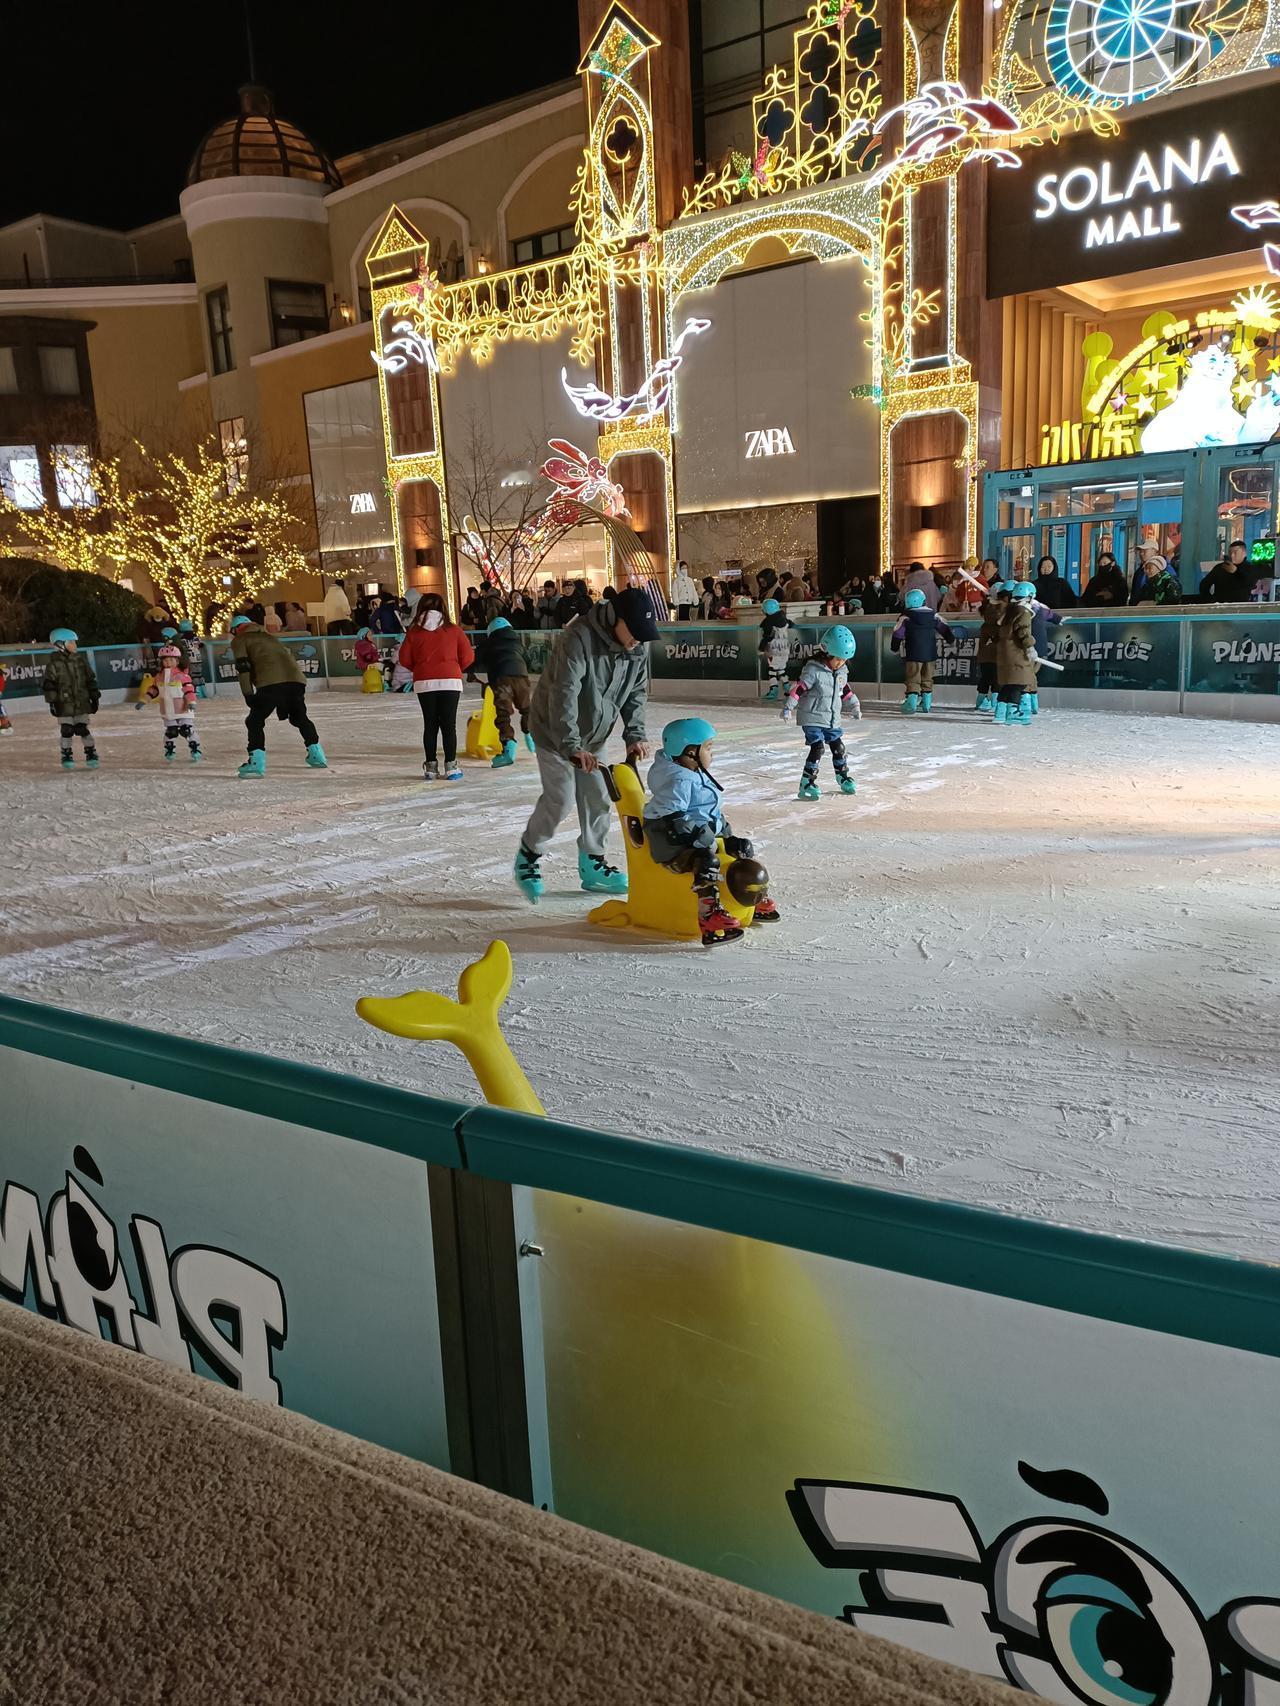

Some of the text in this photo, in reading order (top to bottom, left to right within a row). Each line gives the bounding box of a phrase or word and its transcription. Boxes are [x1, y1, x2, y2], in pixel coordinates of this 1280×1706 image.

[1035, 133, 1241, 219] SOLANA
[1085, 202, 1182, 248] MALL
[744, 425, 797, 459] ZARA
[349, 491, 377, 514] ZARA
[665, 643, 714, 660] PLANET
